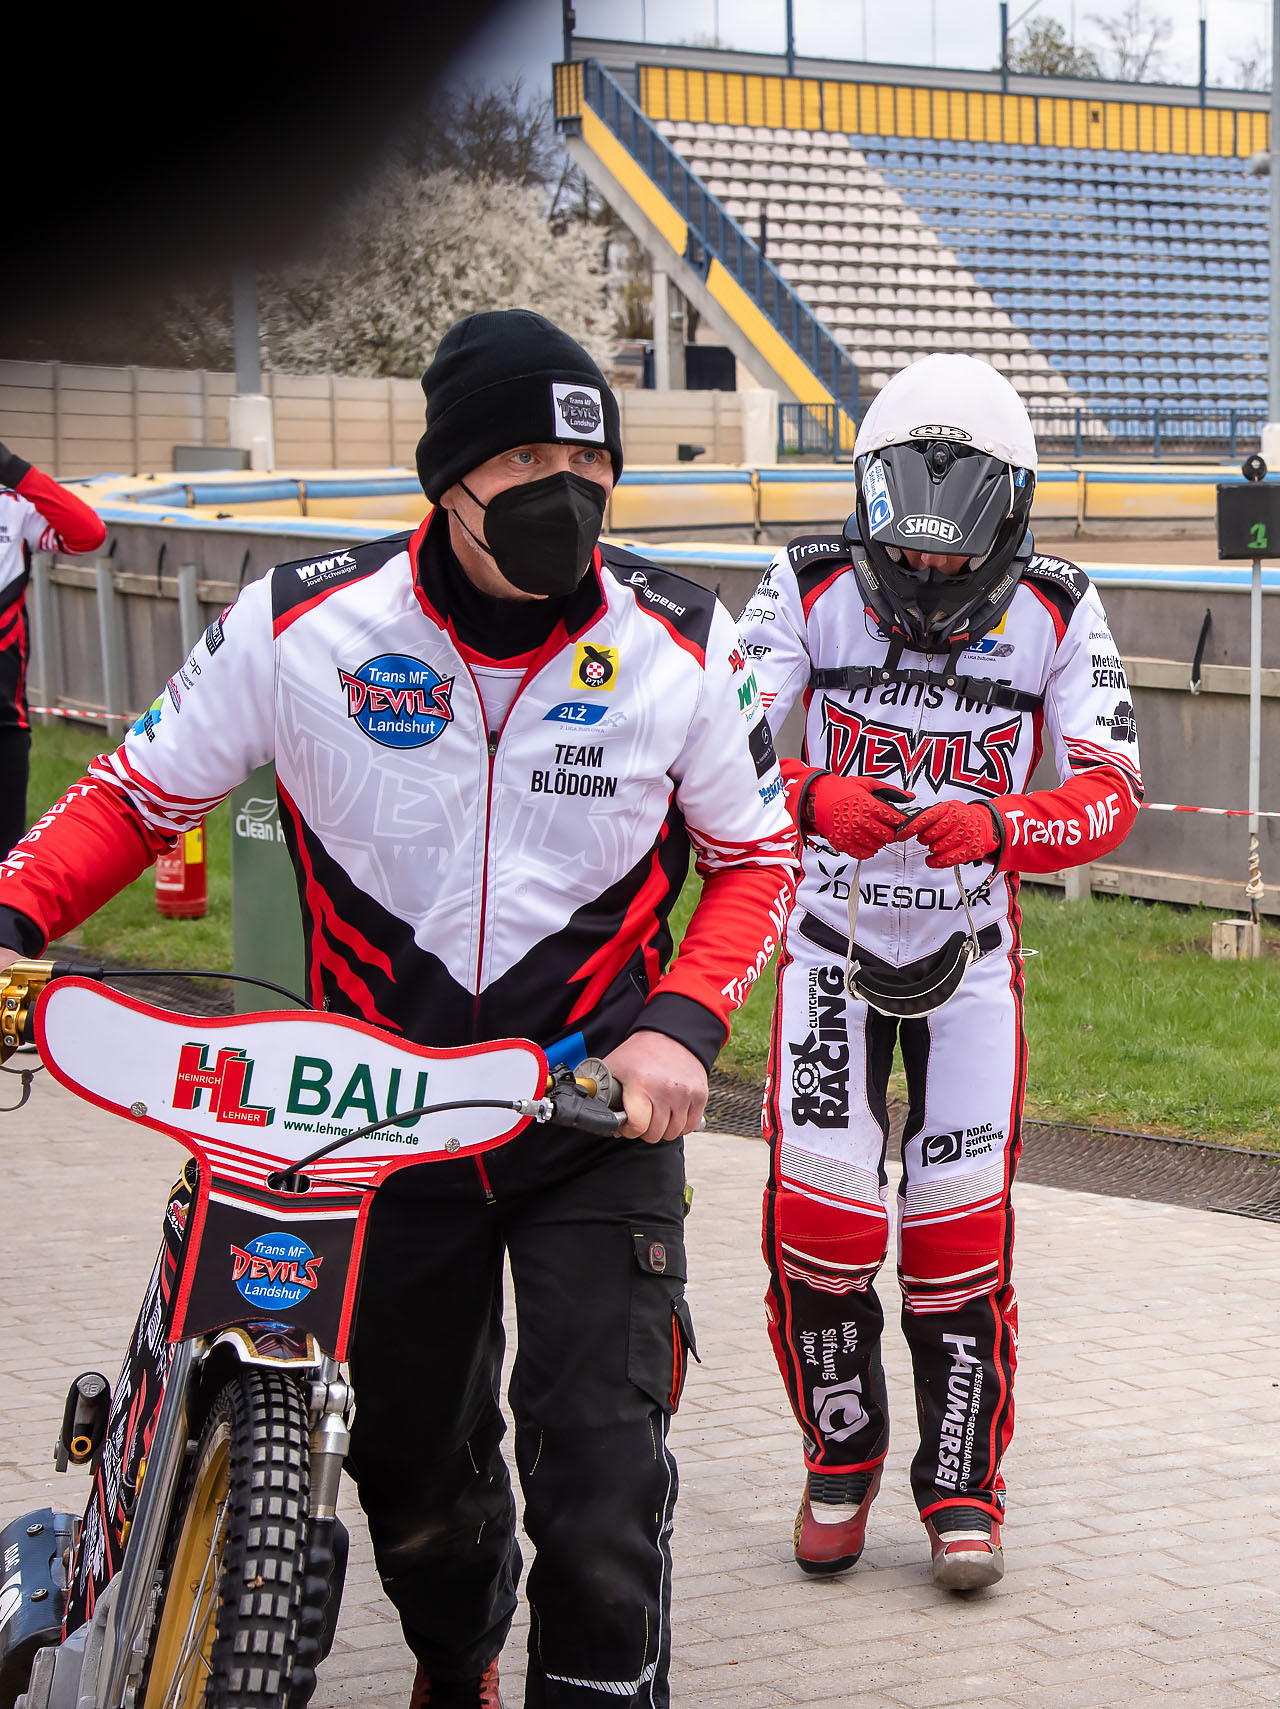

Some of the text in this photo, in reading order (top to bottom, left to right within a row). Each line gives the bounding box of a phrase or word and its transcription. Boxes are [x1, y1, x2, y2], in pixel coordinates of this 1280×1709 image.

[556, 397, 601, 424] DEVILS
[570, 419, 595, 428] Landshut
[905, 519, 955, 541] SHOEI
[789, 543, 841, 561] Trans
[295, 552, 356, 581] WWK
[323, 564, 358, 580] Schwaiger
[1034, 567, 1082, 600] SCHWAIGER
[643, 585, 686, 616] ispeed
[369, 668, 429, 685] Trans MF
[585, 677, 604, 687] PZM
[337, 667, 455, 722] DEVILS
[368, 717, 436, 734] Landshut
[558, 705, 588, 722] 2LŻ
[554, 743, 604, 768] TEAM
[820, 692, 1022, 798] DEVILS
[530, 768, 618, 798] BLÖDORN
[235, 814, 274, 841] Clean
[1005, 810, 1082, 847] Trans
[1084, 793, 1121, 842] MF
[721, 935, 775, 1010] Trans
[817, 965, 851, 1129] RACING
[178, 1072, 222, 1086] HEINRICH
[286, 1055, 428, 1129] BAU
[222, 1110, 261, 1122] LEHNER
[966, 1123, 993, 1138] ADAC
[965, 1143, 992, 1158] Sport
[255, 1242, 306, 1258] Trans MF
[230, 1244, 324, 1290] DEVILS
[244, 1282, 301, 1300] Landshut
[802, 1330, 819, 1366] Sport
